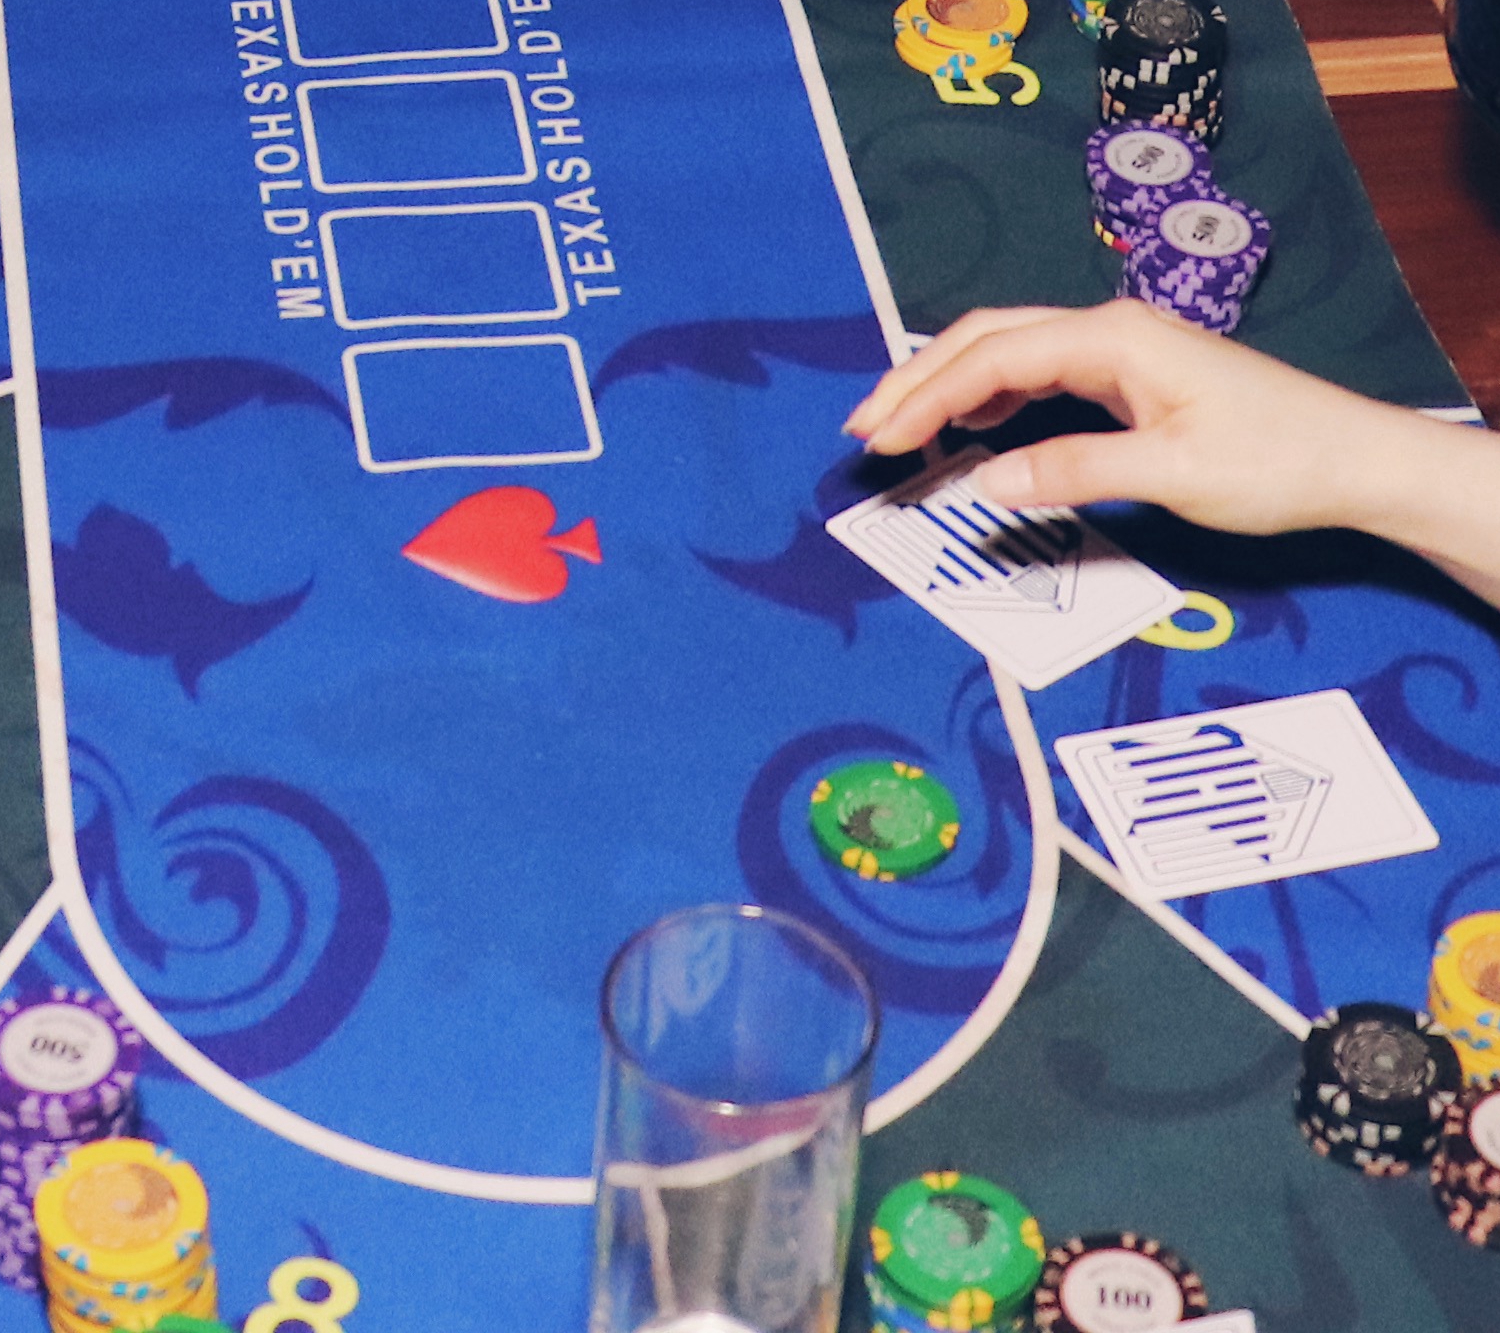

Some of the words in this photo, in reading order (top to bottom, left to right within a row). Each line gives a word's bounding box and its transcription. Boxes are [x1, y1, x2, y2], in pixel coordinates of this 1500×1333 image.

[545, 156, 622, 308] TEXAS
[29, 1034, 84, 1063] 500
[1098, 1286, 1151, 1310] 100
